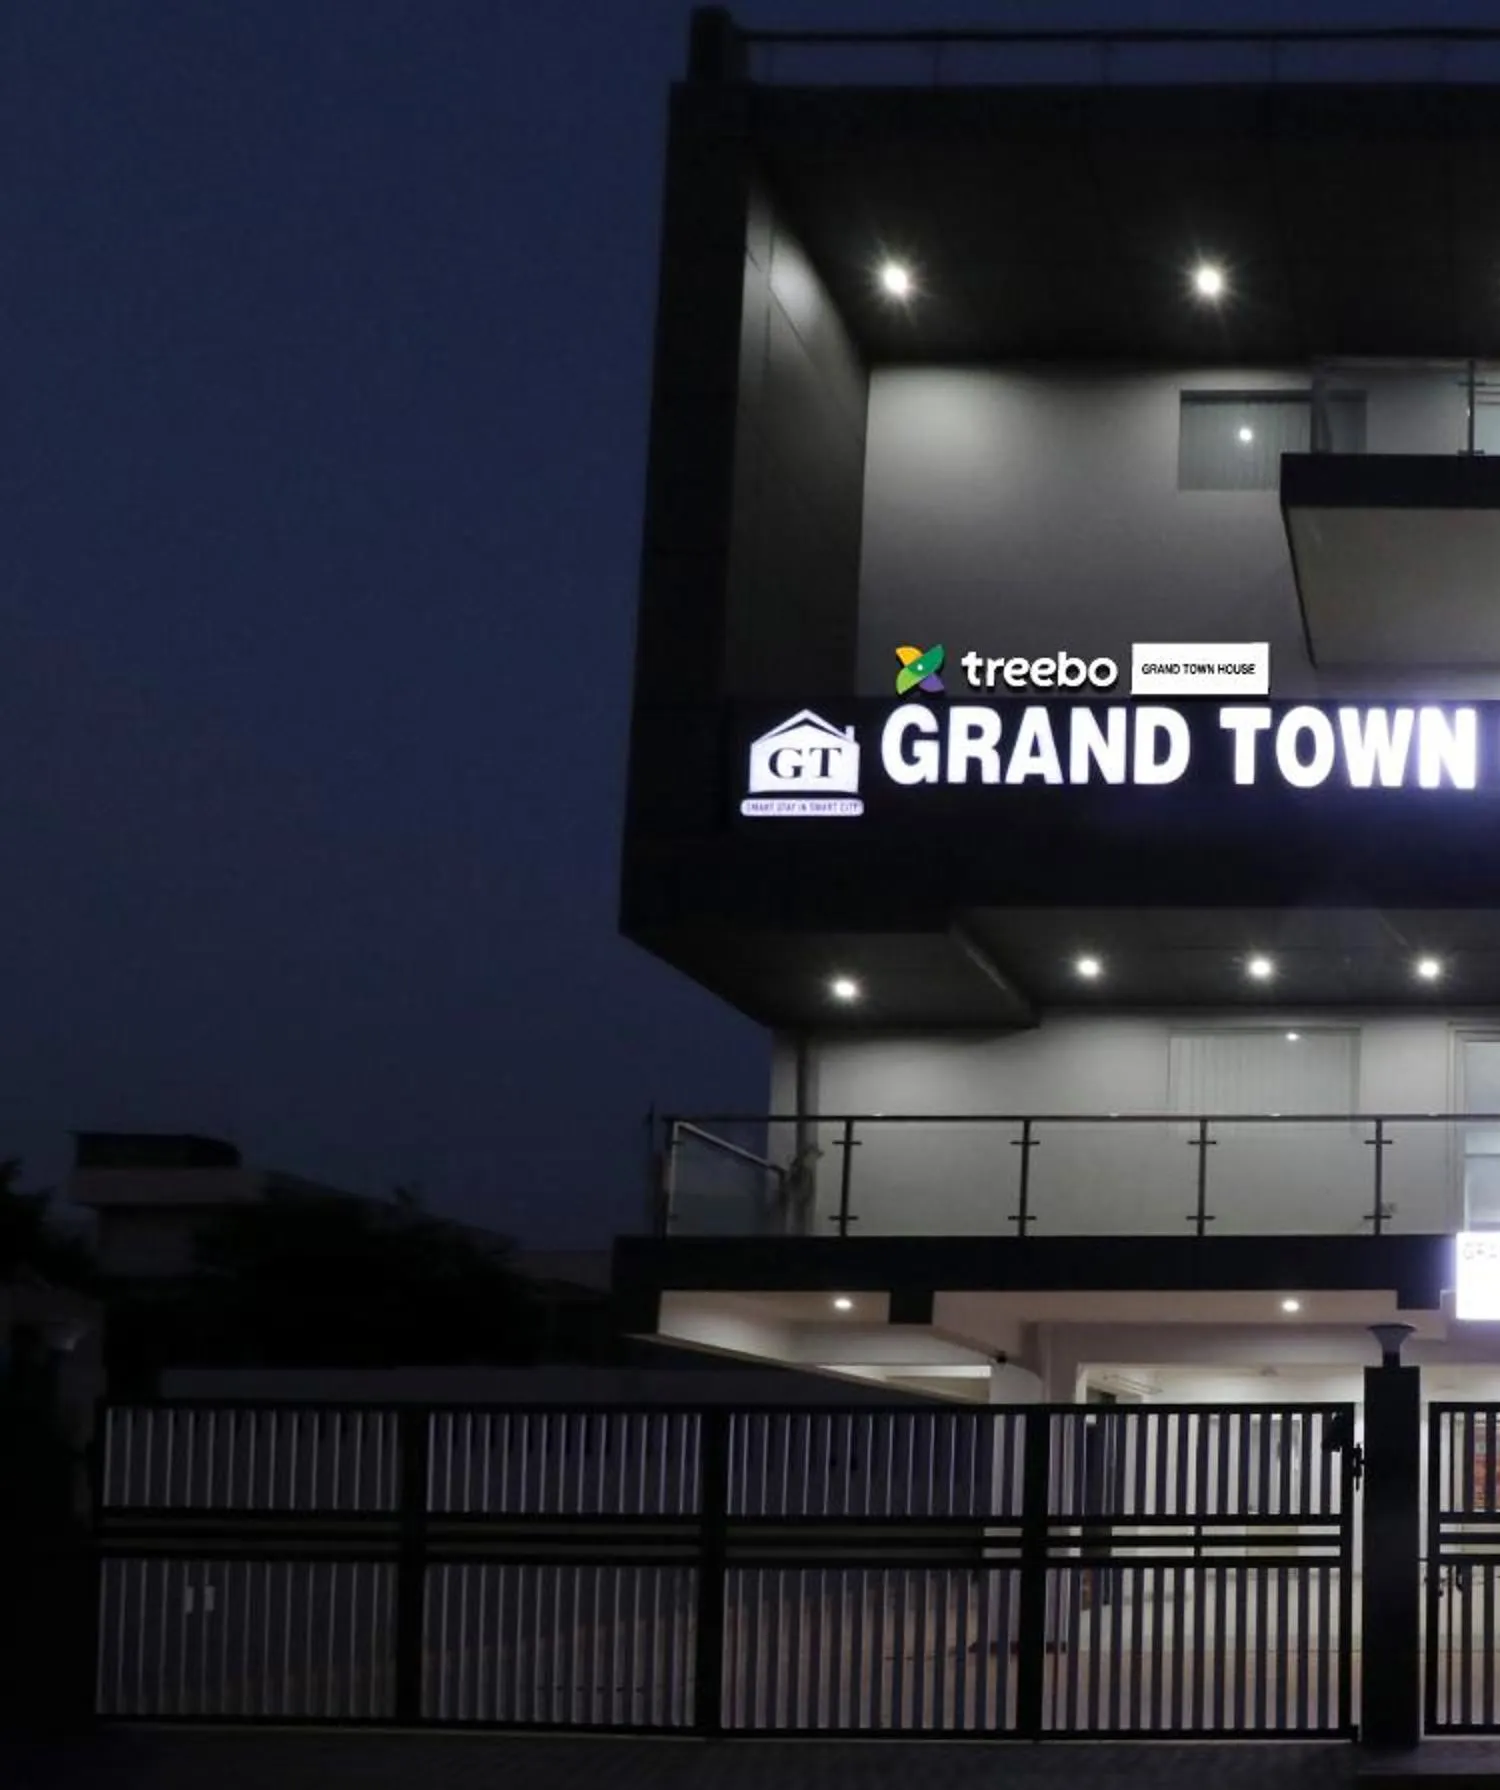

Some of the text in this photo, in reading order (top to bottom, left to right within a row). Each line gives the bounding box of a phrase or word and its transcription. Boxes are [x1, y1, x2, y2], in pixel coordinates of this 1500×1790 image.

[961, 651, 1118, 687] treebo
[1141, 663, 1256, 675] GRAND TOWN HOUSE
[768, 747, 842, 779] GT
[881, 704, 1190, 785] GRAND
[1219, 705, 1479, 790] TOWN
